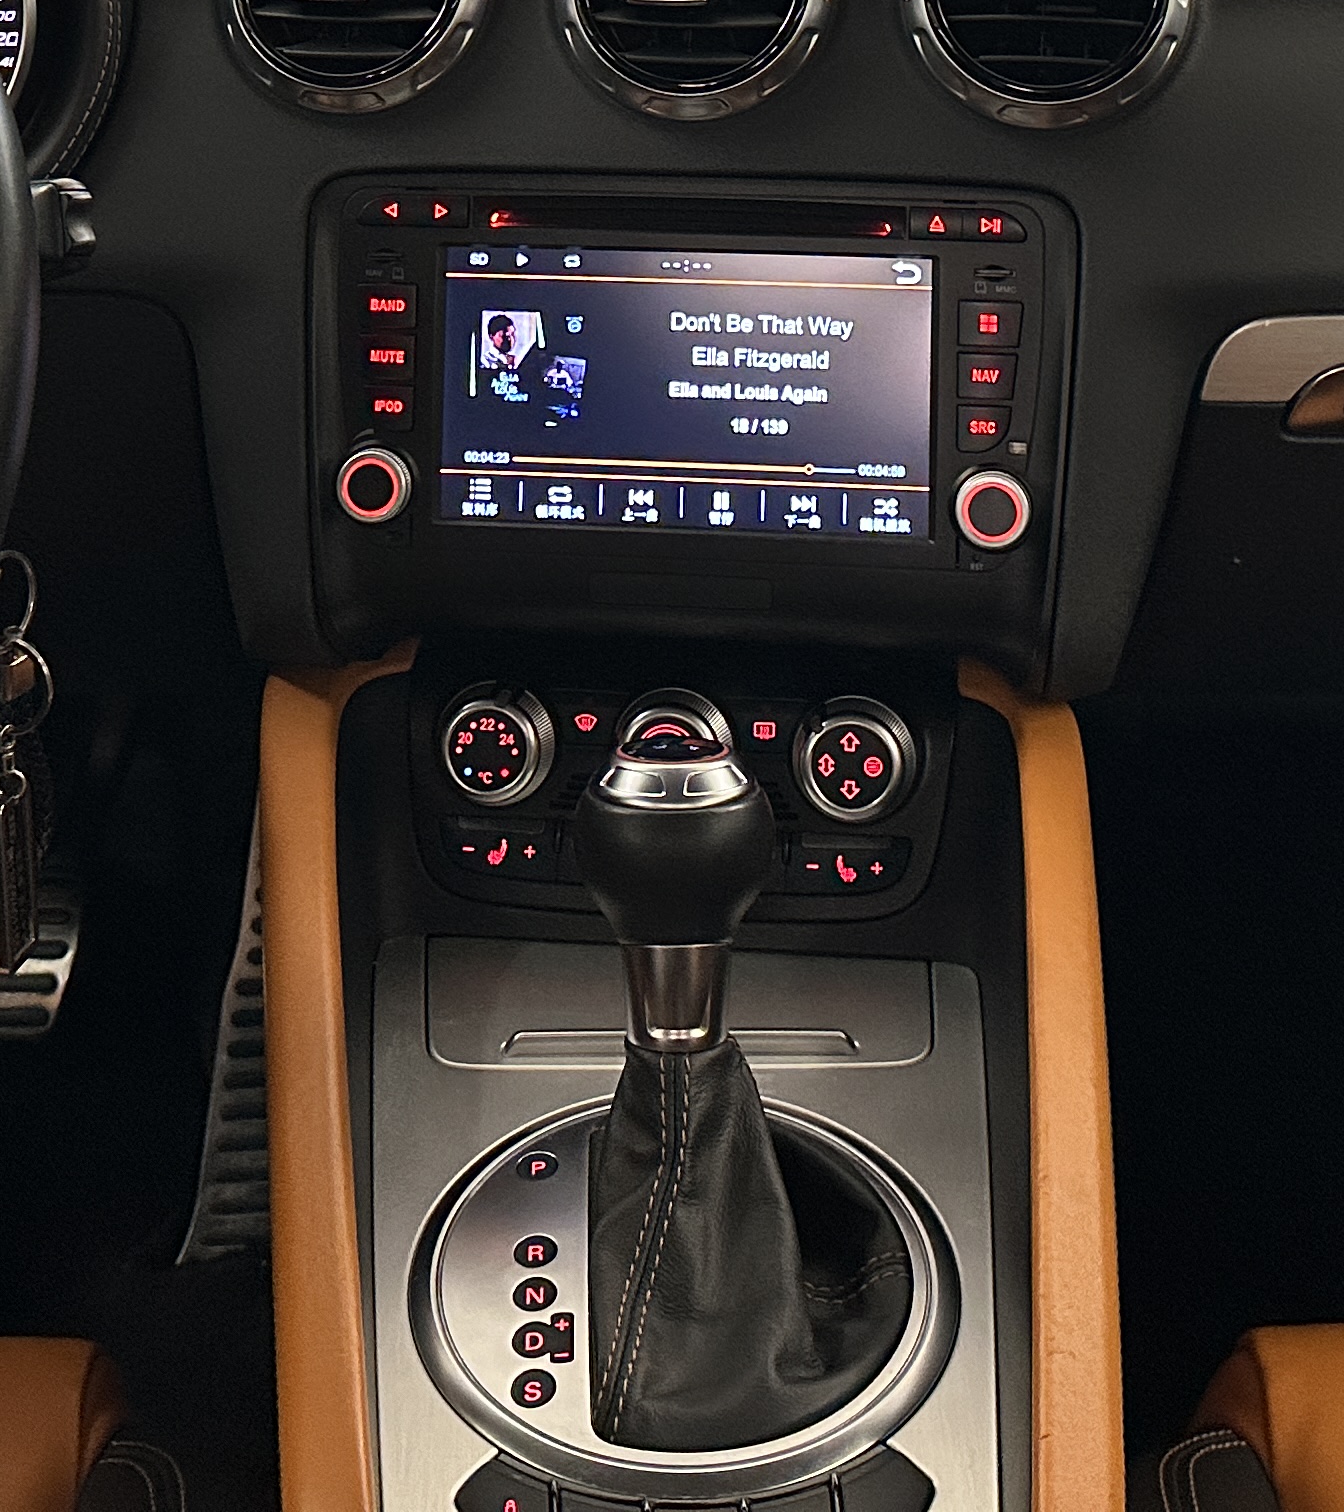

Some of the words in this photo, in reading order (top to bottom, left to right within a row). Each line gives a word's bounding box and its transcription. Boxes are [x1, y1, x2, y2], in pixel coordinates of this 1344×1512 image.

[370, 298, 406, 312] BAND
[670, 311, 721, 332] Don't
[726, 314, 754, 333] Be
[757, 314, 804, 335] That
[808, 316, 854, 340] Way
[370, 349, 405, 364] MUTE
[692, 346, 729, 366] Ella
[734, 348, 830, 372] Fitzgerald
[971, 368, 1000, 383] NAV
[668, 381, 698, 398] Ella
[701, 383, 731, 400] and
[734, 384, 778, 400] Louis
[780, 385, 828, 405] Again
[374, 400, 404, 413] IPOD
[969, 420, 997, 434] SRC
[479, 717, 495, 731] 22
[457, 731, 473, 745] 20
[499, 733, 515, 746] 24
[477, 771, 493, 784] °C
[531, 1161, 546, 1175] P
[527, 1245, 544, 1262] R
[525, 1287, 544, 1305] N
[525, 1332, 544, 1350] D
[524, 1381, 542, 1401] S
